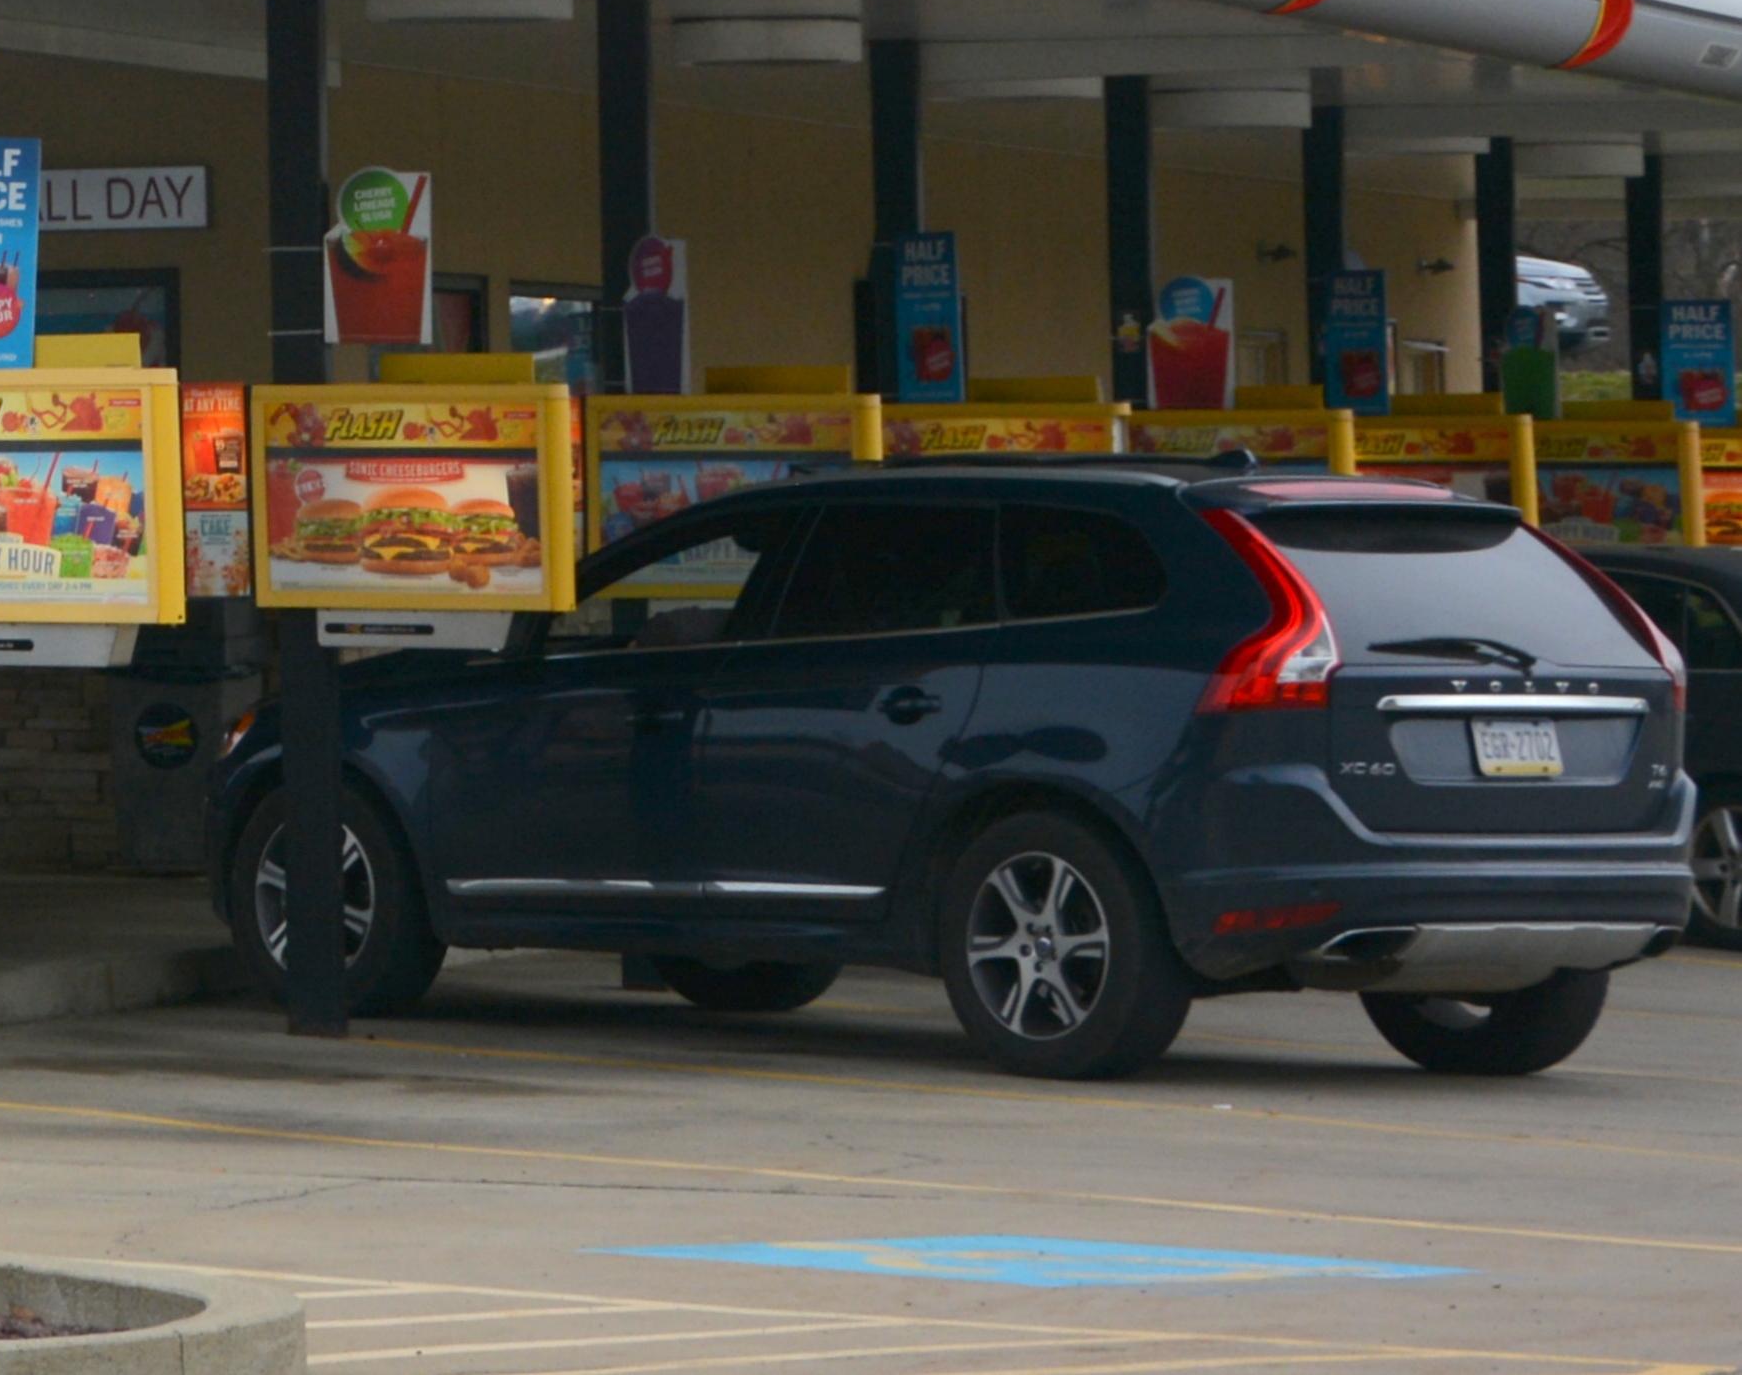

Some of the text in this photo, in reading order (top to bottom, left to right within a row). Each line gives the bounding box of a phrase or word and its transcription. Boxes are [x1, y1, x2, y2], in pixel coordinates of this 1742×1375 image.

[40, 178, 92, 222] LL
[106, 175, 195, 222] DAY
[354, 187, 393, 200] CHERRY
[904, 239, 946, 261] HALF
[902, 264, 950, 286] PRICE
[1672, 305, 1720, 321] HALF
[1669, 324, 1726, 340] PRICE
[325, 407, 404, 441] FLASH
[653, 414, 724, 445] FLASH
[7, 548, 56, 576] HOUR
[1451, 680, 1600, 693] VOLVO
